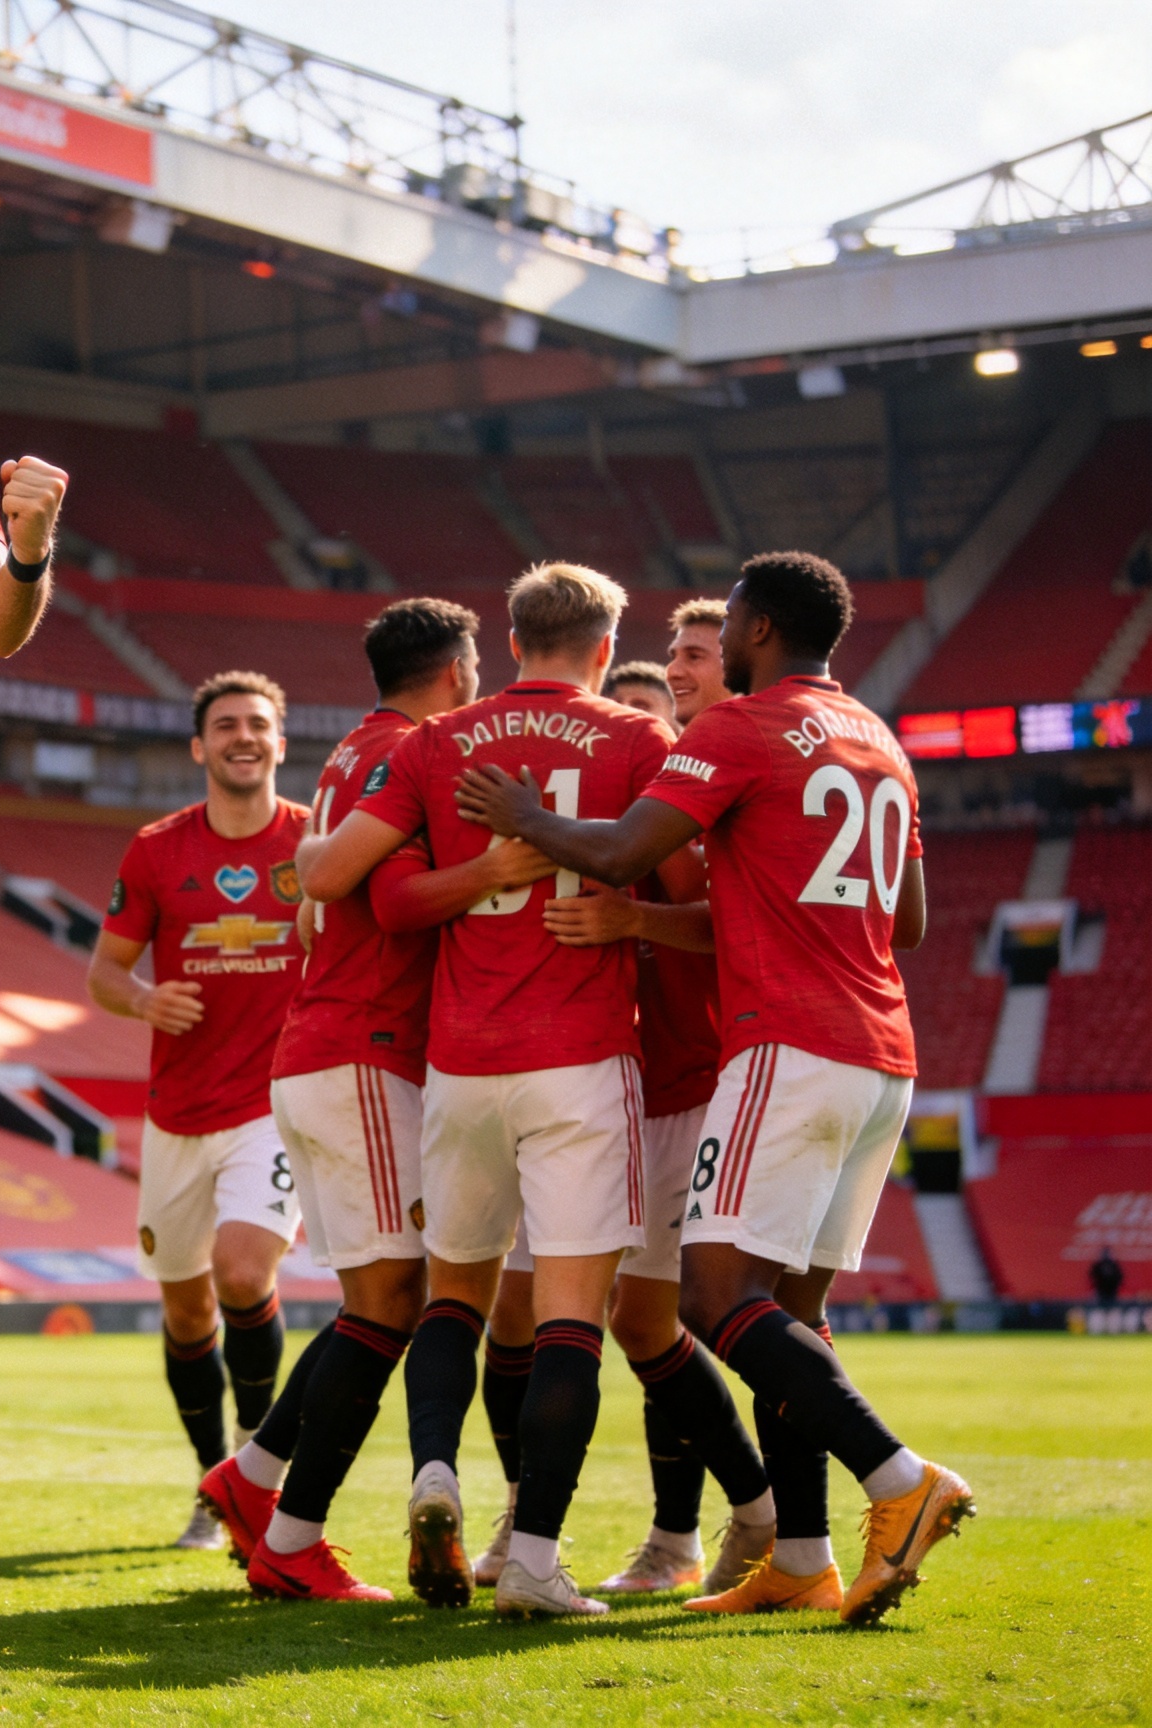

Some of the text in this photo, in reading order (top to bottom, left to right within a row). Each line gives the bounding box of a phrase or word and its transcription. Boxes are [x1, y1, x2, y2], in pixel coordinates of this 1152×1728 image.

[797, 764, 911, 915] 20
[271, 1151, 294, 1193] 8
[692, 1136, 720, 1192] 8
